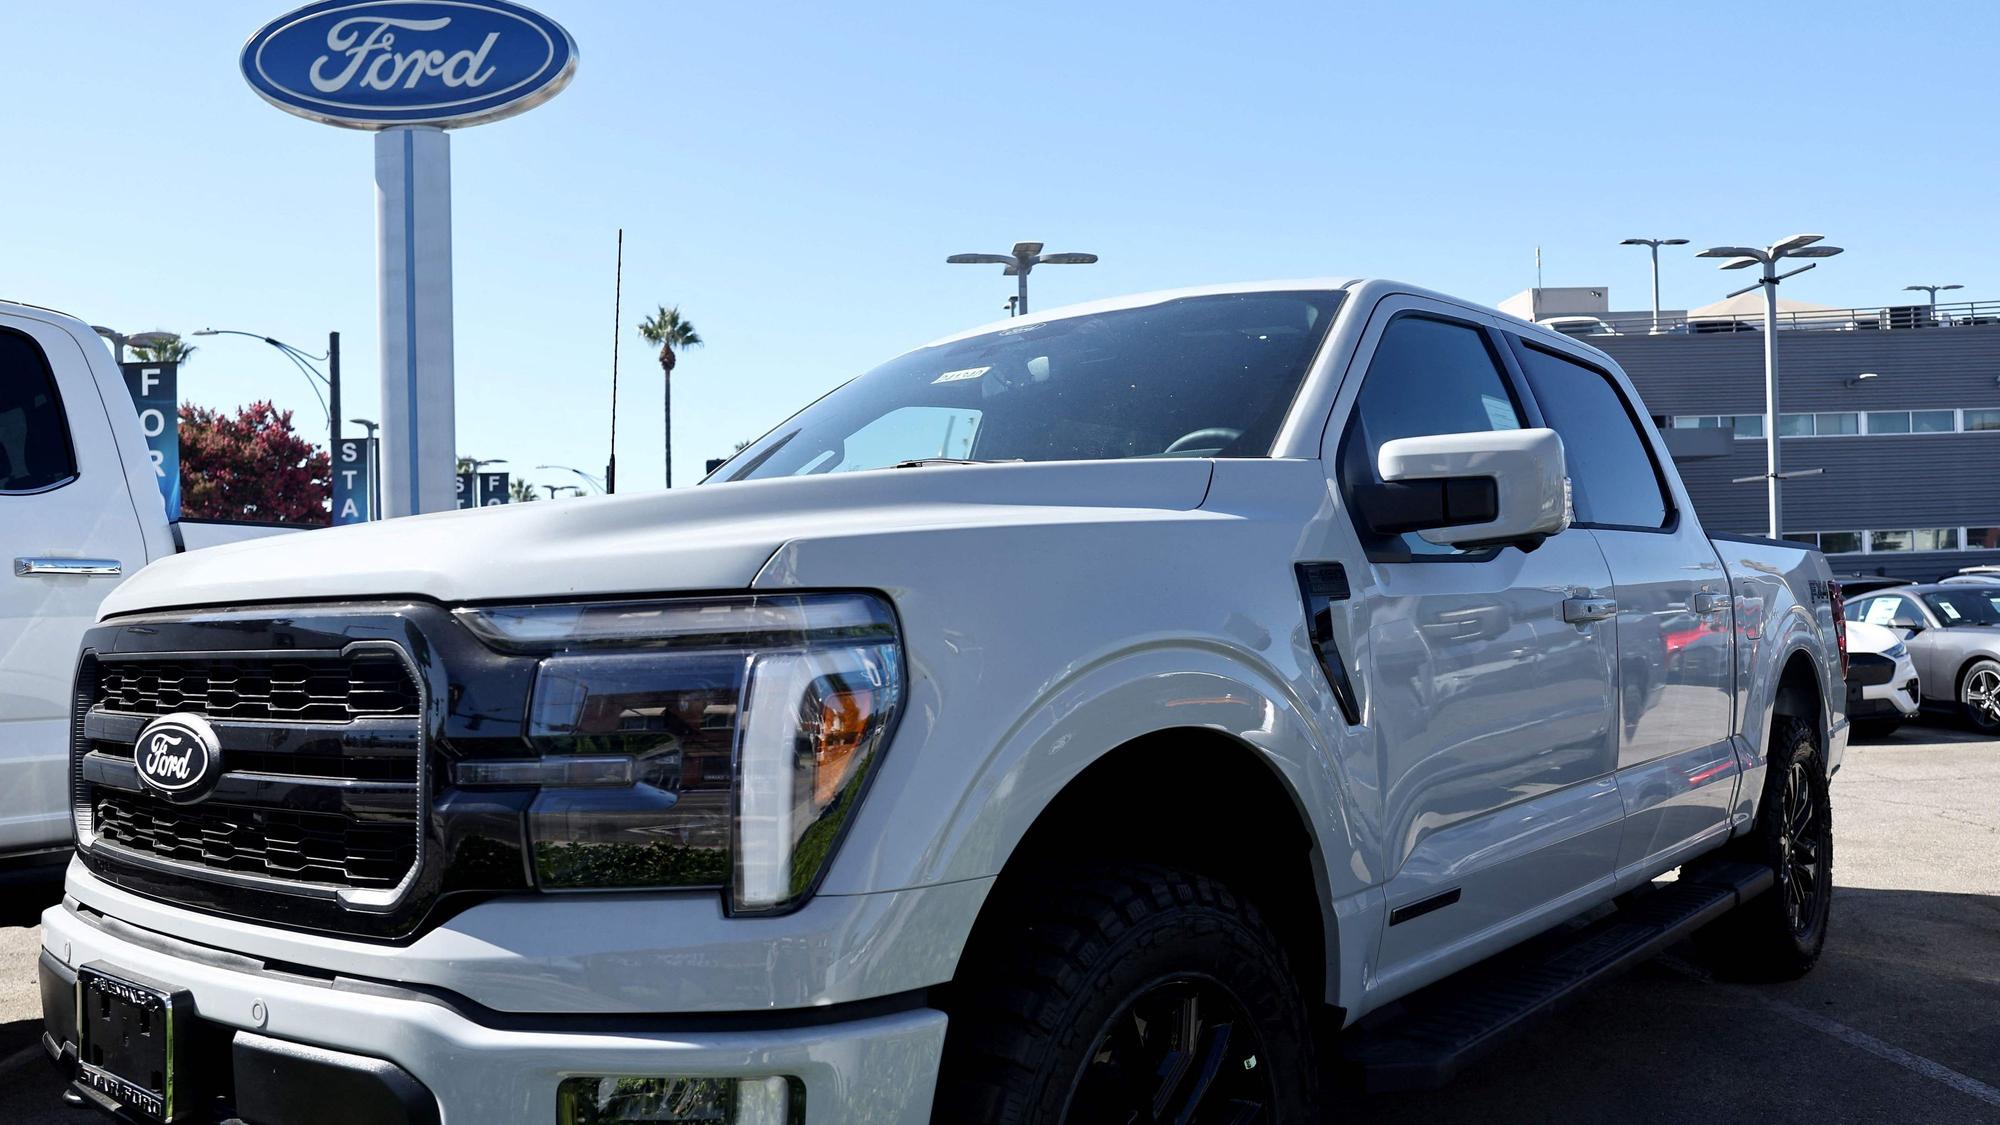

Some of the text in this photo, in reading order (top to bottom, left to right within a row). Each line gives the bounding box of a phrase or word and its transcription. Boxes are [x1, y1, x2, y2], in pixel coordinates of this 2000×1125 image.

[309, 16, 501, 93] Ford
[139, 368, 166, 477] FOR
[146, 733, 193, 779] Ford
[81, 1069, 162, 1117] STAR FORD
